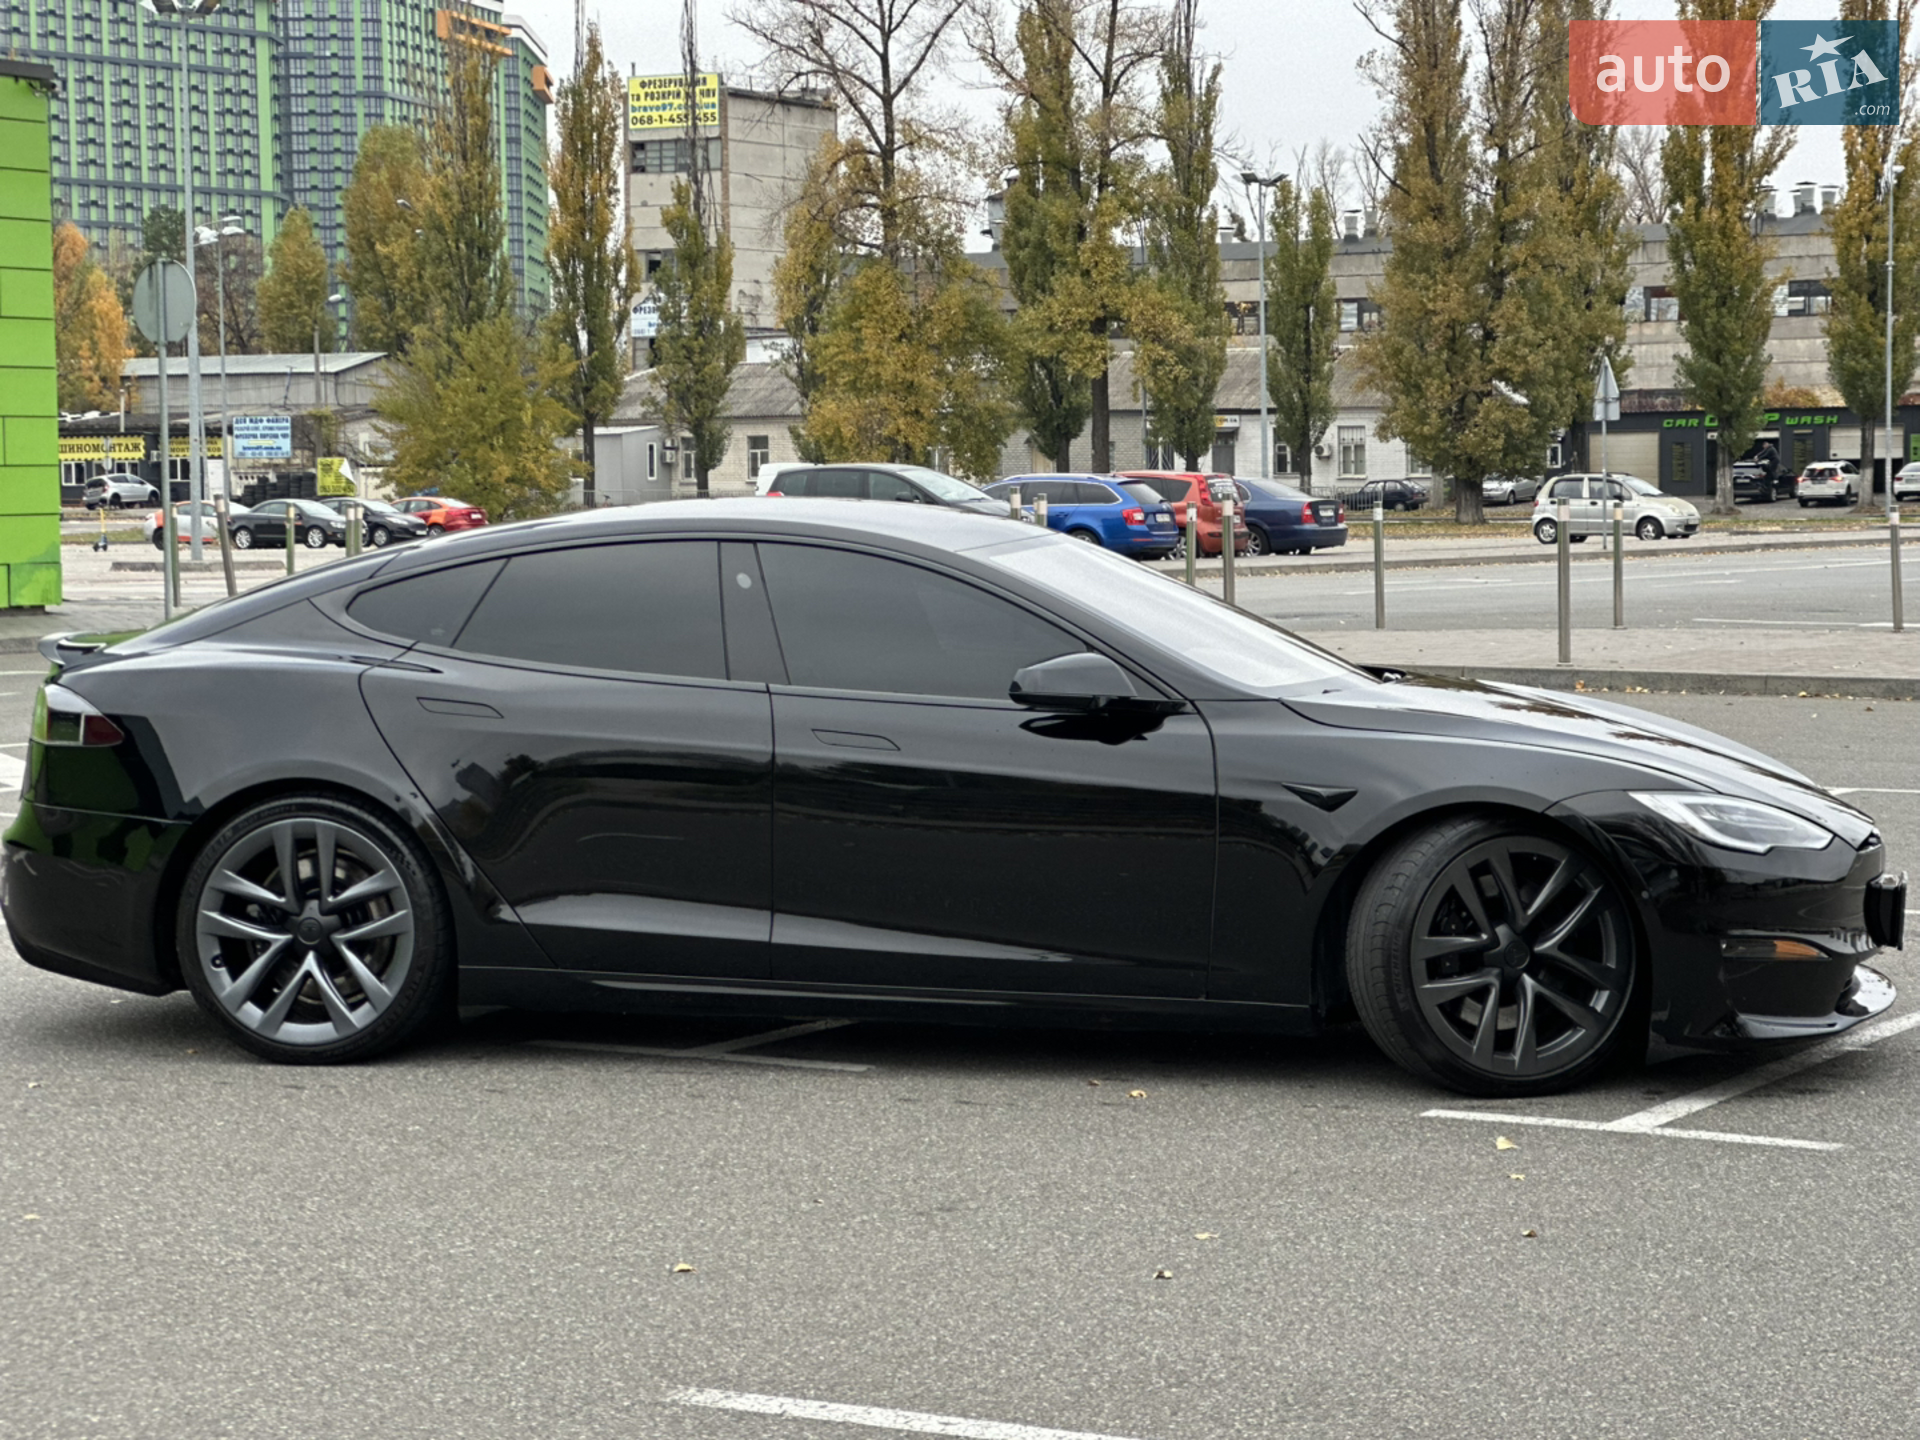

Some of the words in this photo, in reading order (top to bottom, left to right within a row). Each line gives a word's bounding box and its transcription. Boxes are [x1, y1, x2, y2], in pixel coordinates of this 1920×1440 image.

[639, 77, 707, 89] ФРЕЗЕРУВНЯ
[631, 113, 717, 125] 068-1-455455
[1663, 418, 1699, 428] CAR
[1704, 412, 1780, 427] DP
[1785, 415, 1838, 425] WASH
[58, 443, 142, 454] ШИНОМОНТАЖ
[1391, 931, 1404, 996] MICHELIN
